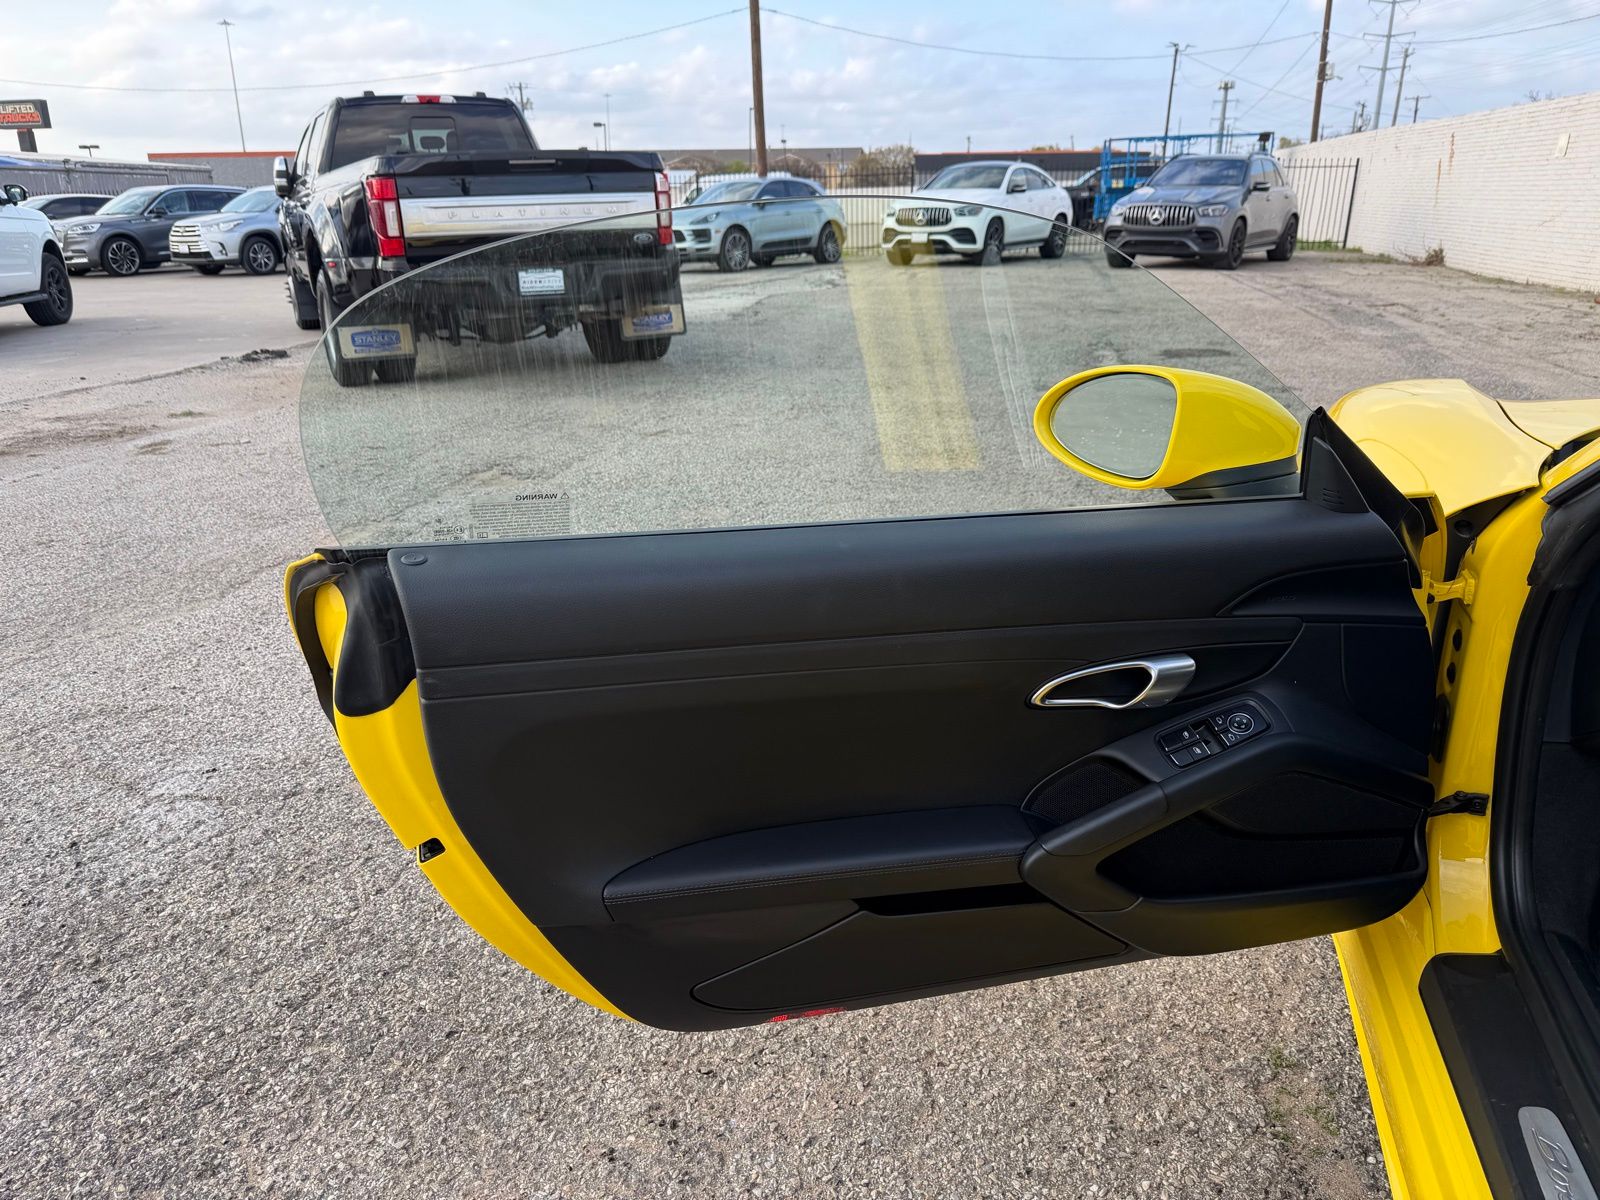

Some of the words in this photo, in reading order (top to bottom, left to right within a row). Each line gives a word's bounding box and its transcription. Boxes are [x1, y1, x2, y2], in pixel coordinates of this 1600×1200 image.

[0, 105, 35, 114] LIFTED
[0, 112, 40, 122] TRUCKS
[447, 206, 618, 219] PLATINUM
[354, 334, 397, 345] STANLEY
